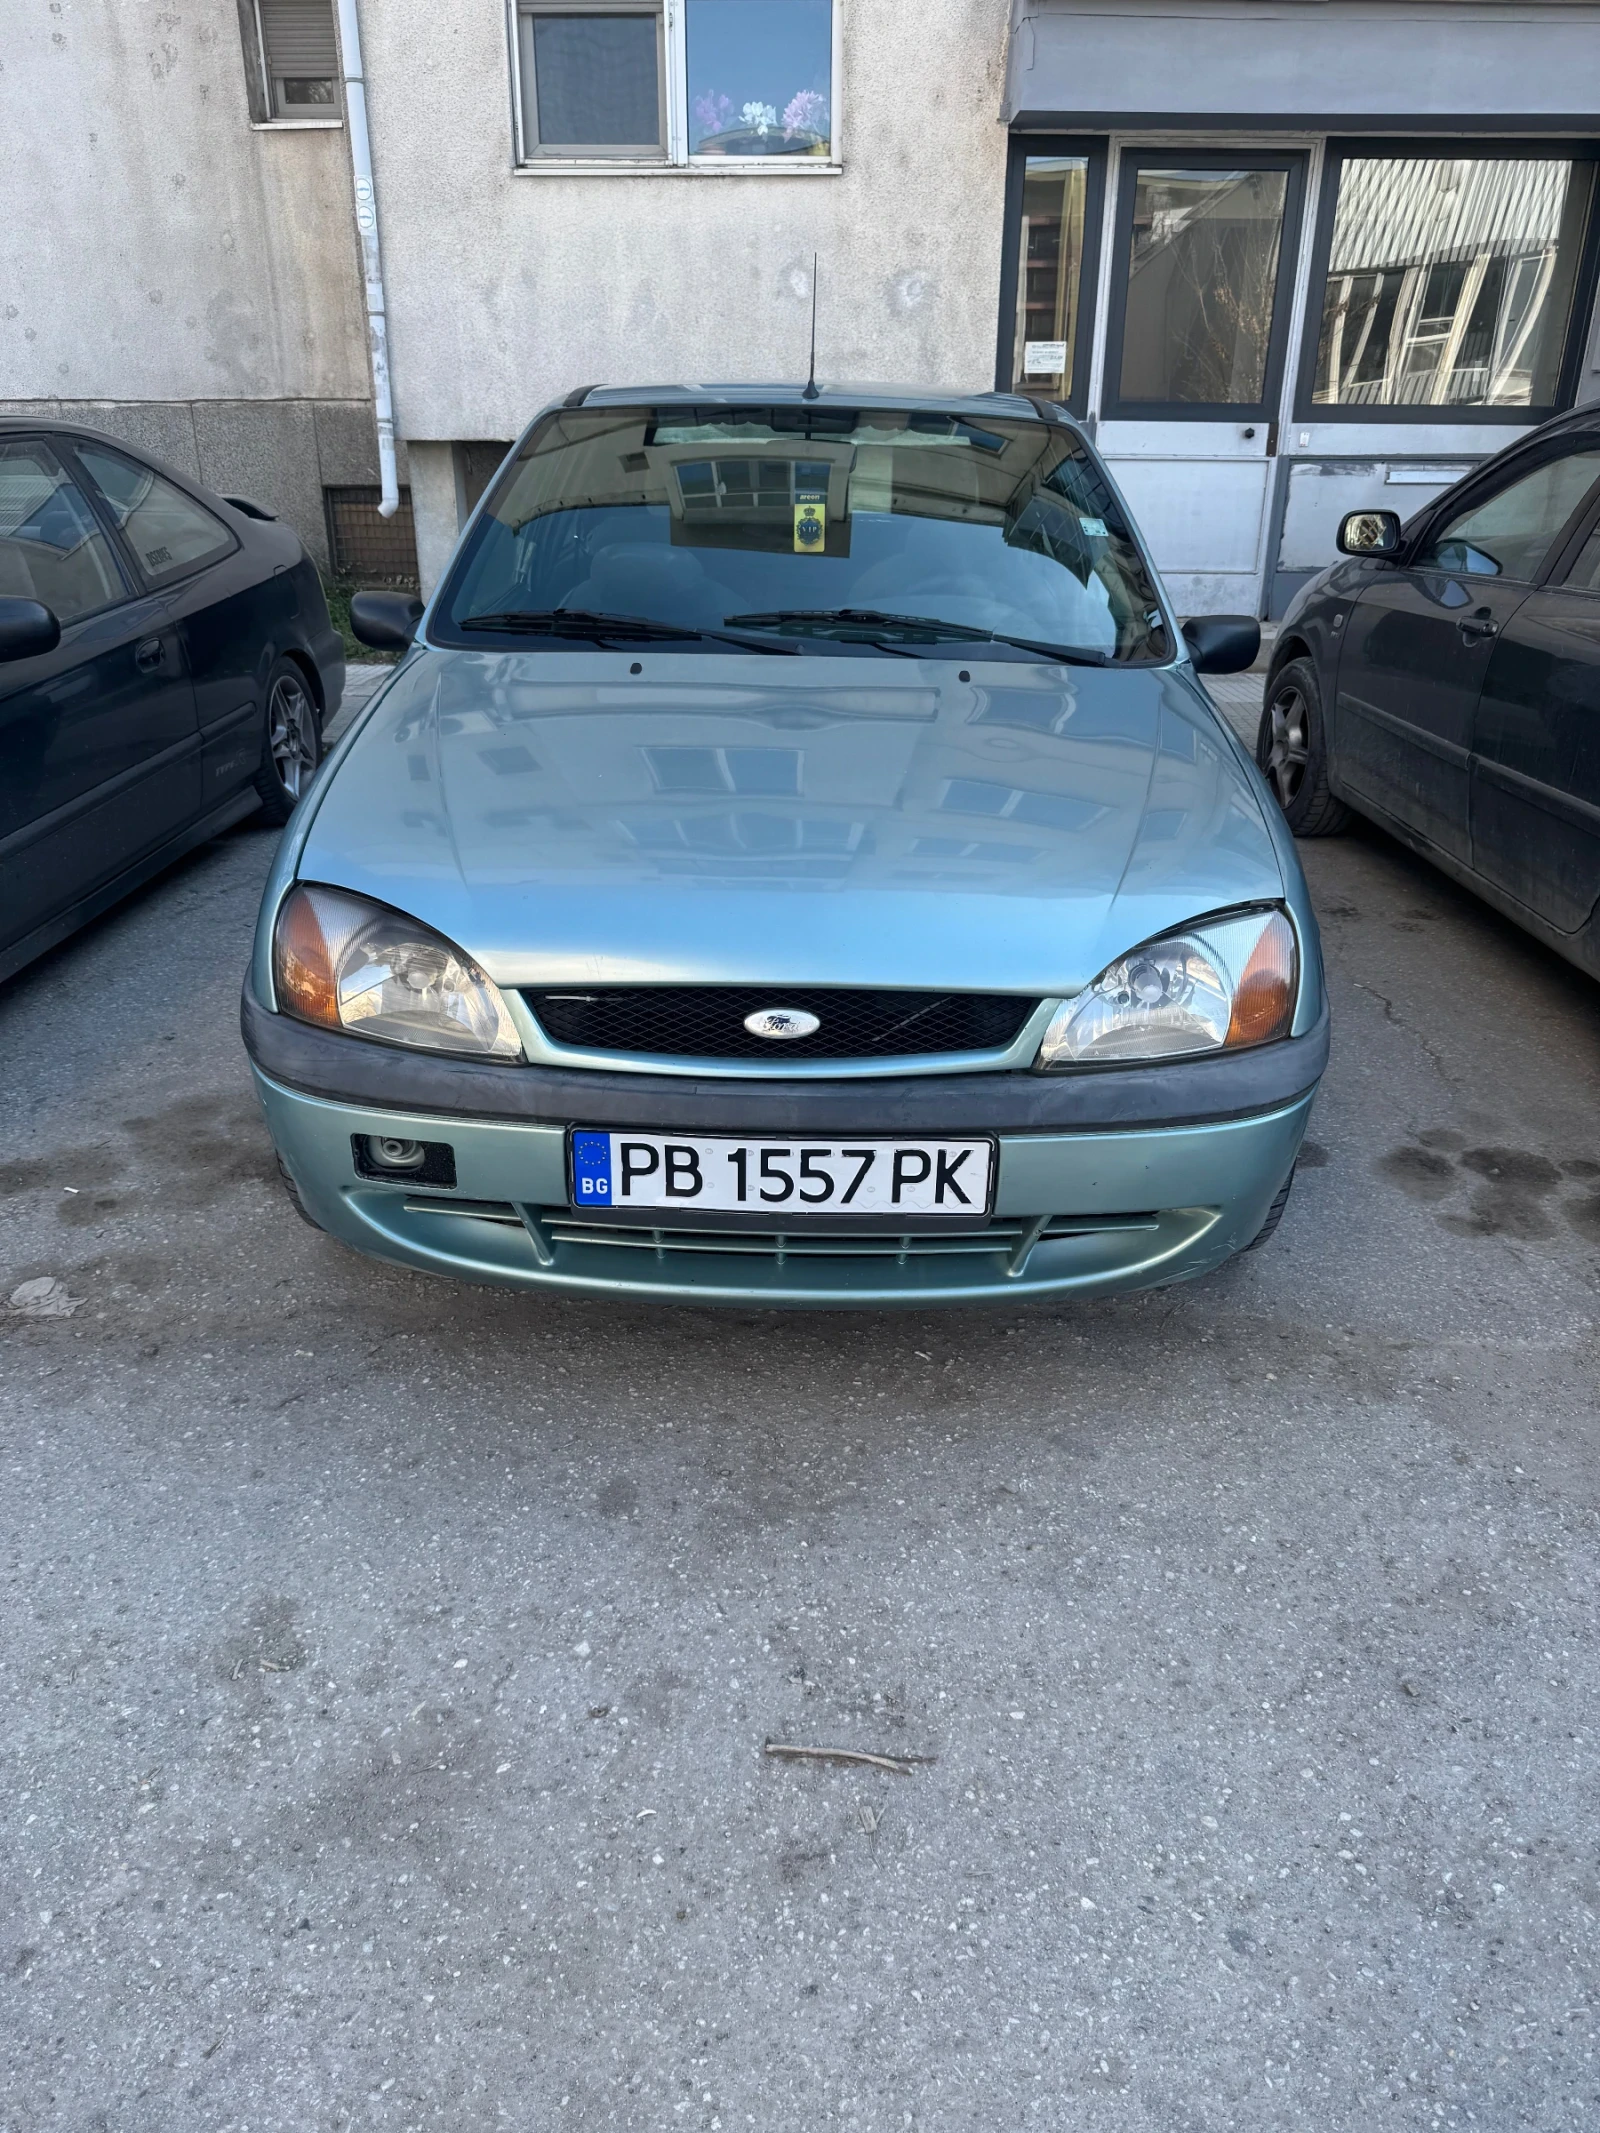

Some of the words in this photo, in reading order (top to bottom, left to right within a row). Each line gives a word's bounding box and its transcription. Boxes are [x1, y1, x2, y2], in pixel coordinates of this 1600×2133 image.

[581, 1176, 609, 1195] BG
[619, 1142, 703, 1198] PB
[726, 1146, 878, 1205] 1557
[890, 1148, 975, 1205] PK
